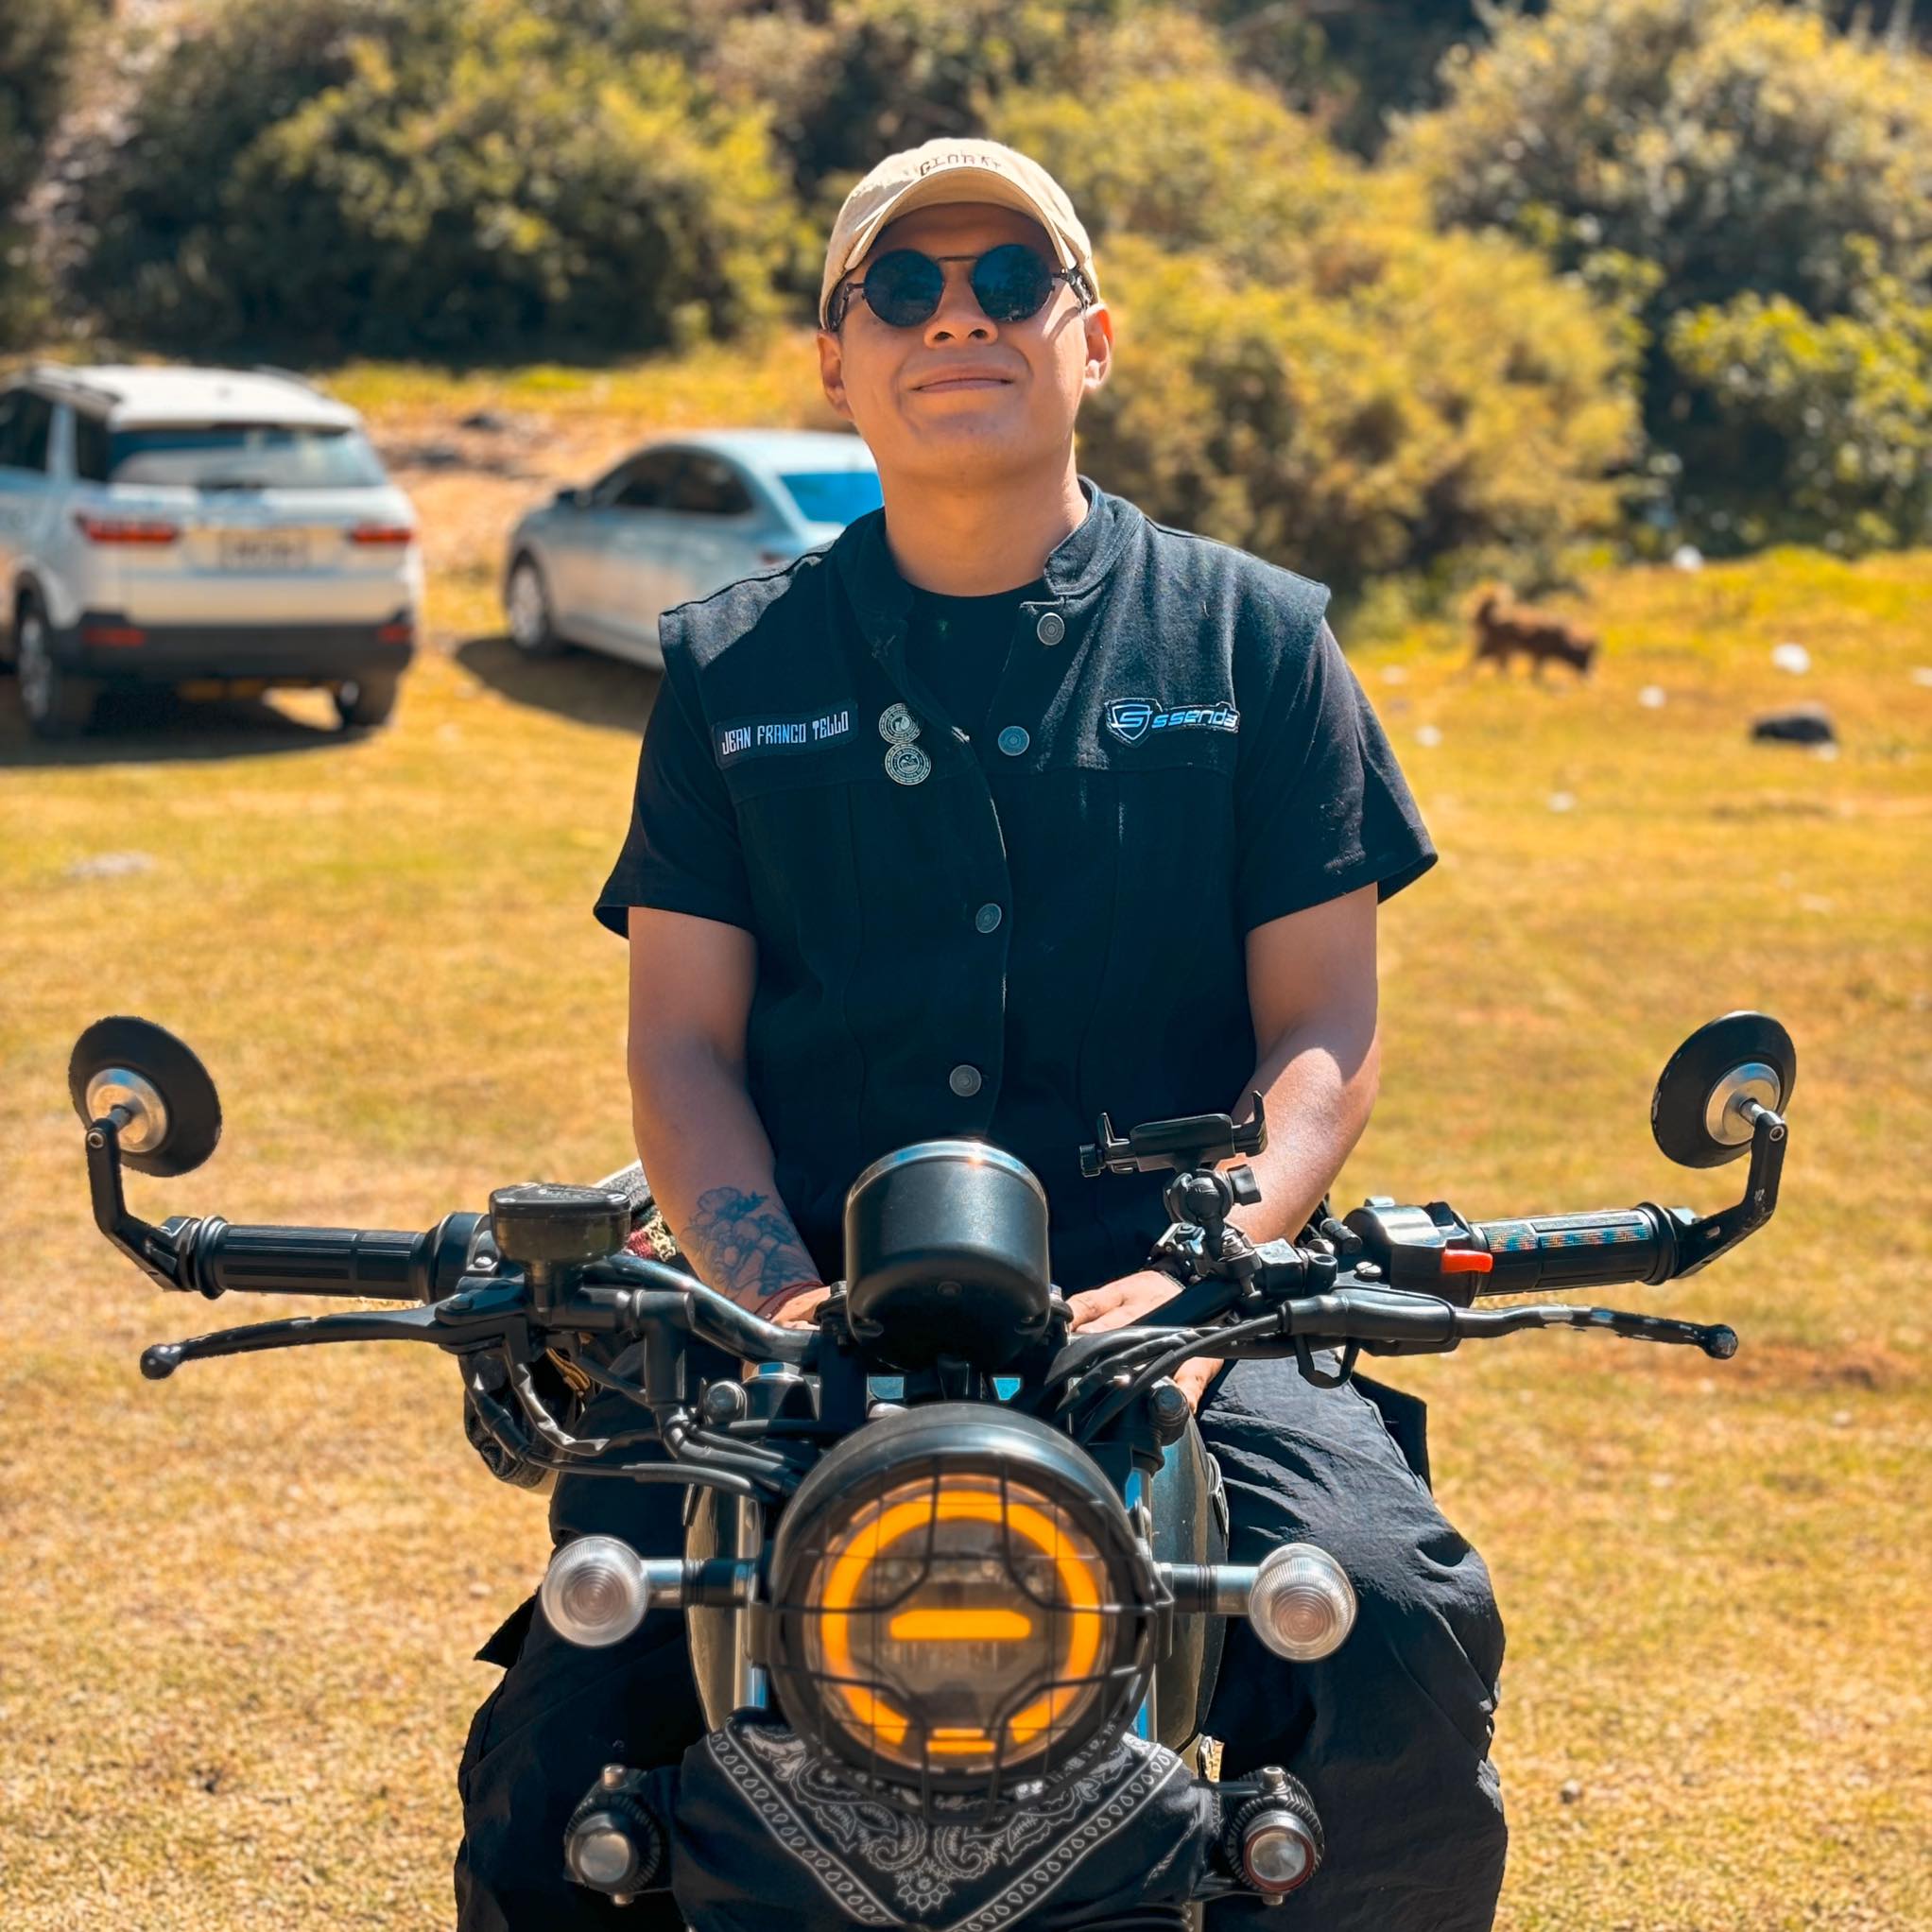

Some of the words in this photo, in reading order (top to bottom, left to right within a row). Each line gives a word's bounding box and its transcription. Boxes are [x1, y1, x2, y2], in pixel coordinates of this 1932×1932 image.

[722, 726, 751, 755] JEAN
[757, 723, 807, 746] FRANCO
[812, 711, 850, 740] TELLO
